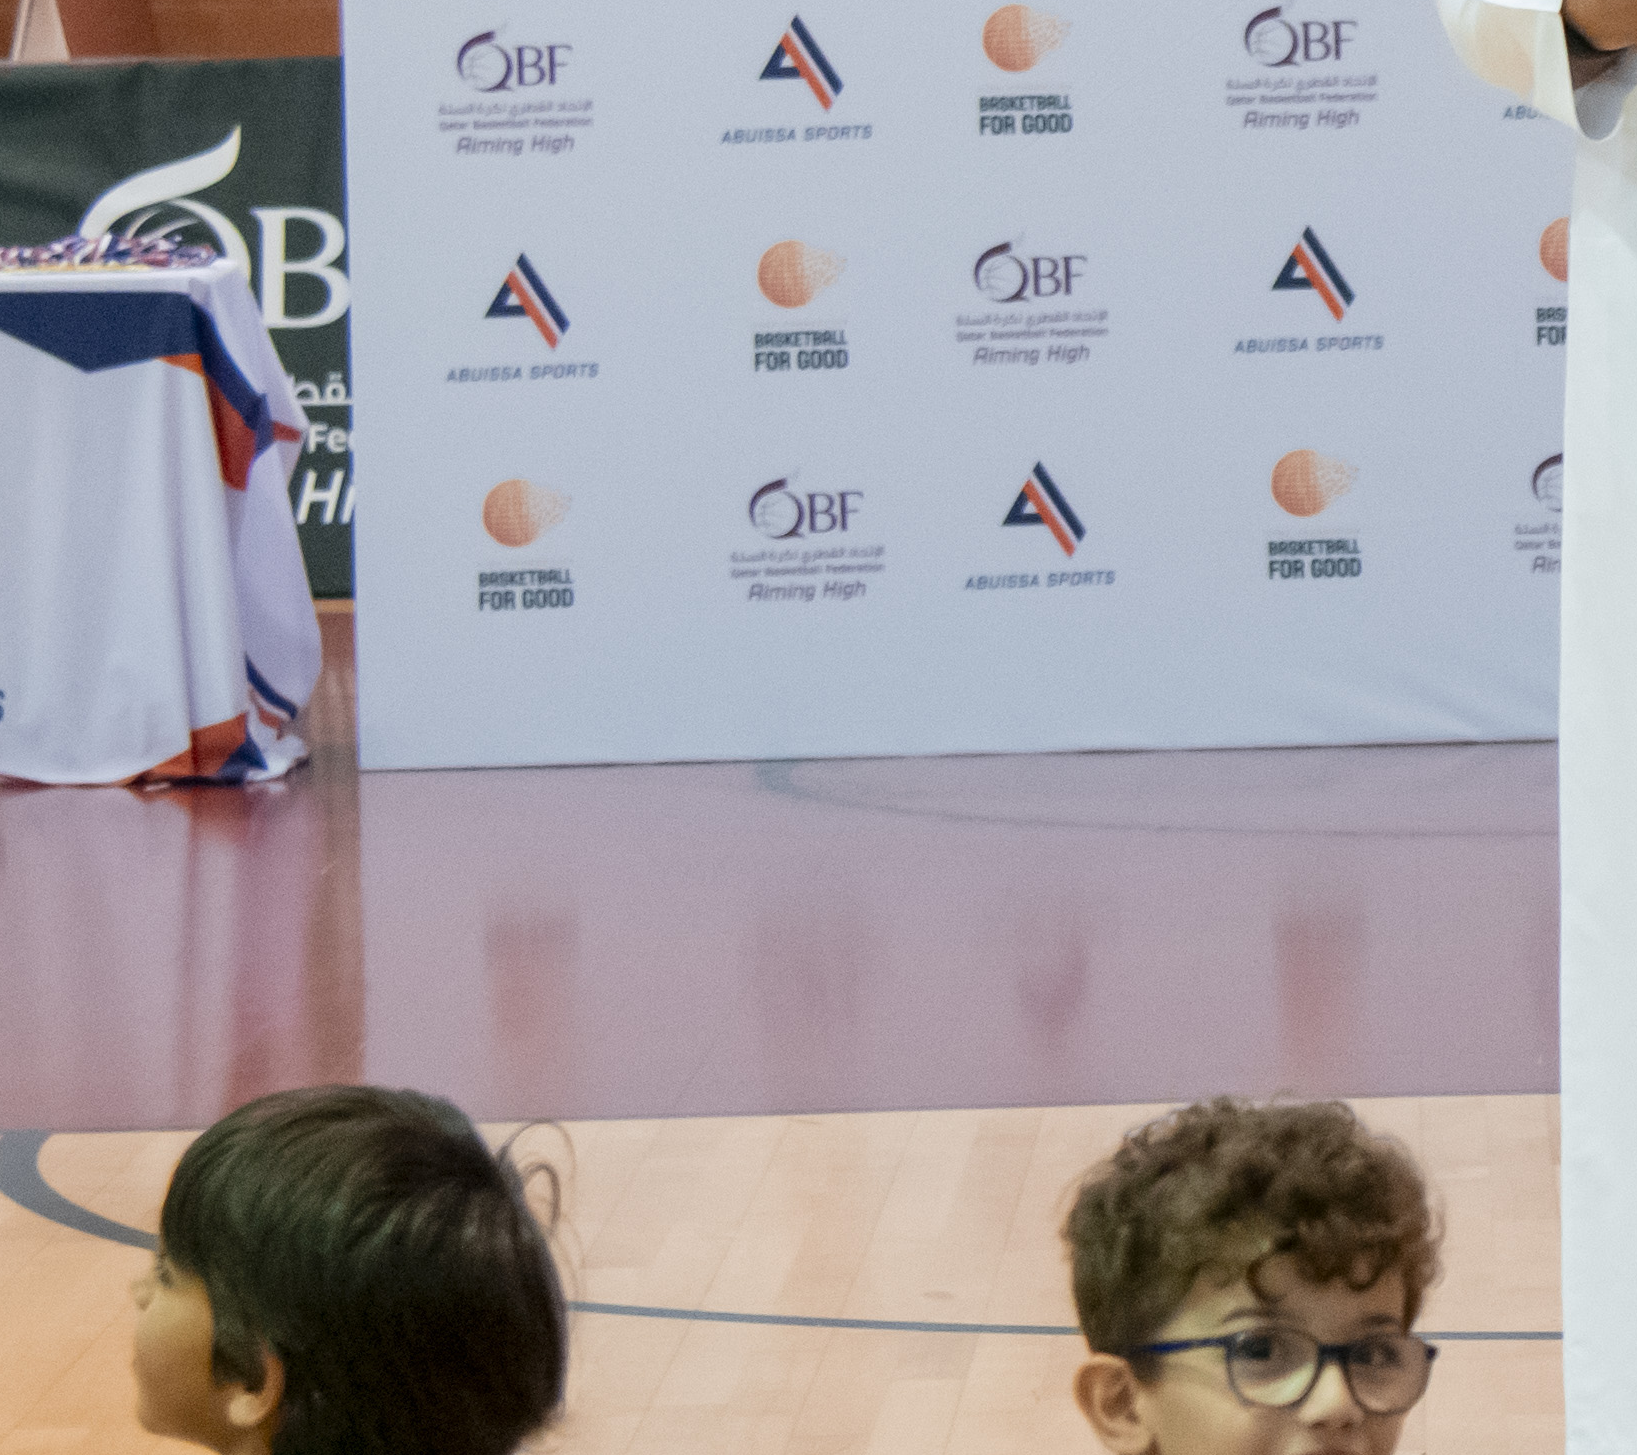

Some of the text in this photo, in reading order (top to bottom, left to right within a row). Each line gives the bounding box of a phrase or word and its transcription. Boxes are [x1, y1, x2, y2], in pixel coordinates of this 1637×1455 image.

[1243, 5, 1358, 68] QBF
[457, 30, 572, 93] QBF
[979, 95, 1072, 112] BASKETBALL
[721, 125, 873, 144] ABUISSA SPORTS
[980, 114, 1074, 135] FOR GOOD
[973, 241, 1088, 304] QBF
[754, 331, 847, 348] BASKETBALL
[1233, 335, 1385, 354] ABUISSA SPORTS
[755, 350, 849, 371] FOR GOOD
[447, 363, 599, 382] ABUISSA SPORTS
[749, 477, 864, 540] QBF
[1268, 539, 1361, 556] BASKETBALL
[479, 570, 572, 587] BASKETBALL
[1269, 558, 1363, 579] FOR GOOD
[964, 571, 1115, 590] ABUISSA SPORTS
[480, 589, 574, 610] FOR GOOD
